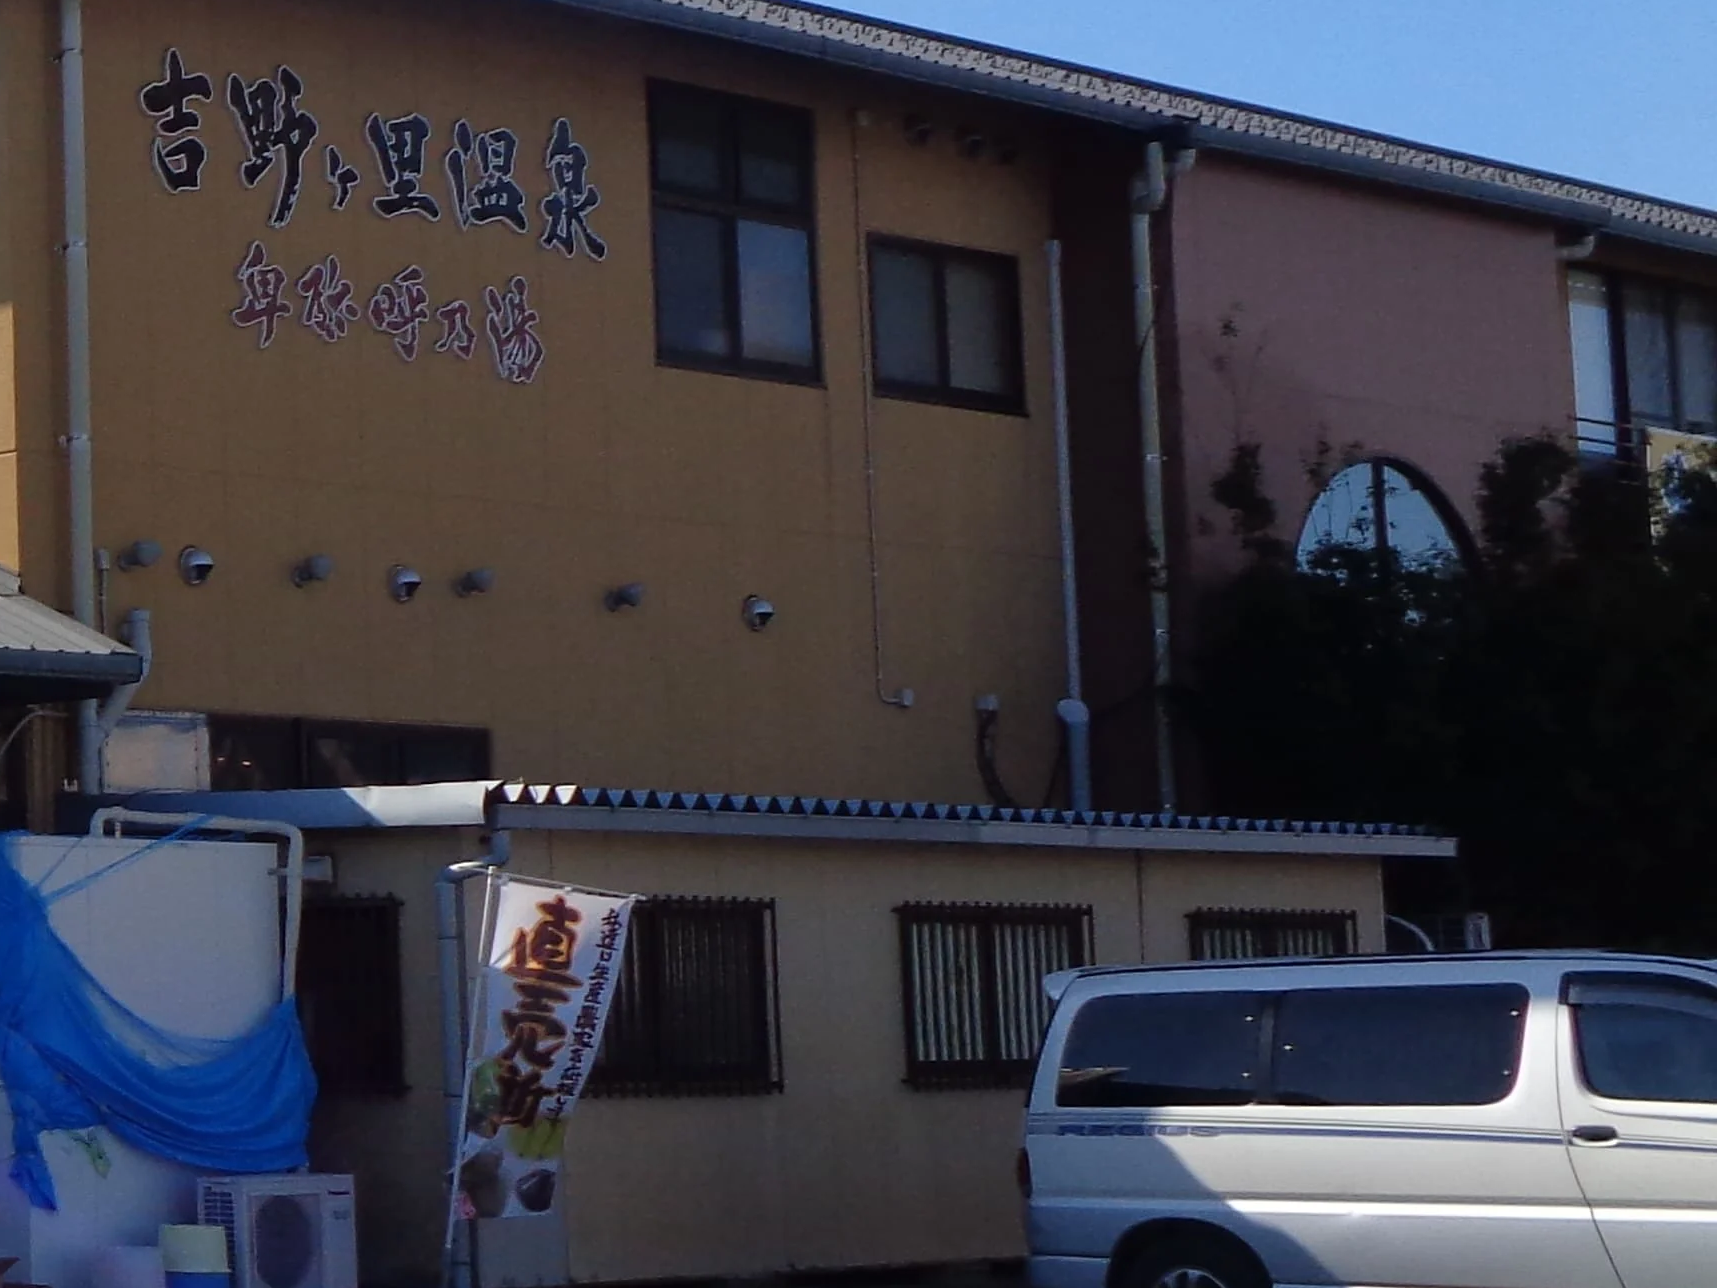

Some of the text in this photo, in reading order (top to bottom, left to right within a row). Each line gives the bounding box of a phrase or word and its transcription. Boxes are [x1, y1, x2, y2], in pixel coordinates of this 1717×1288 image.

[140, 47, 607, 261] 吉野ヶ里温泉
